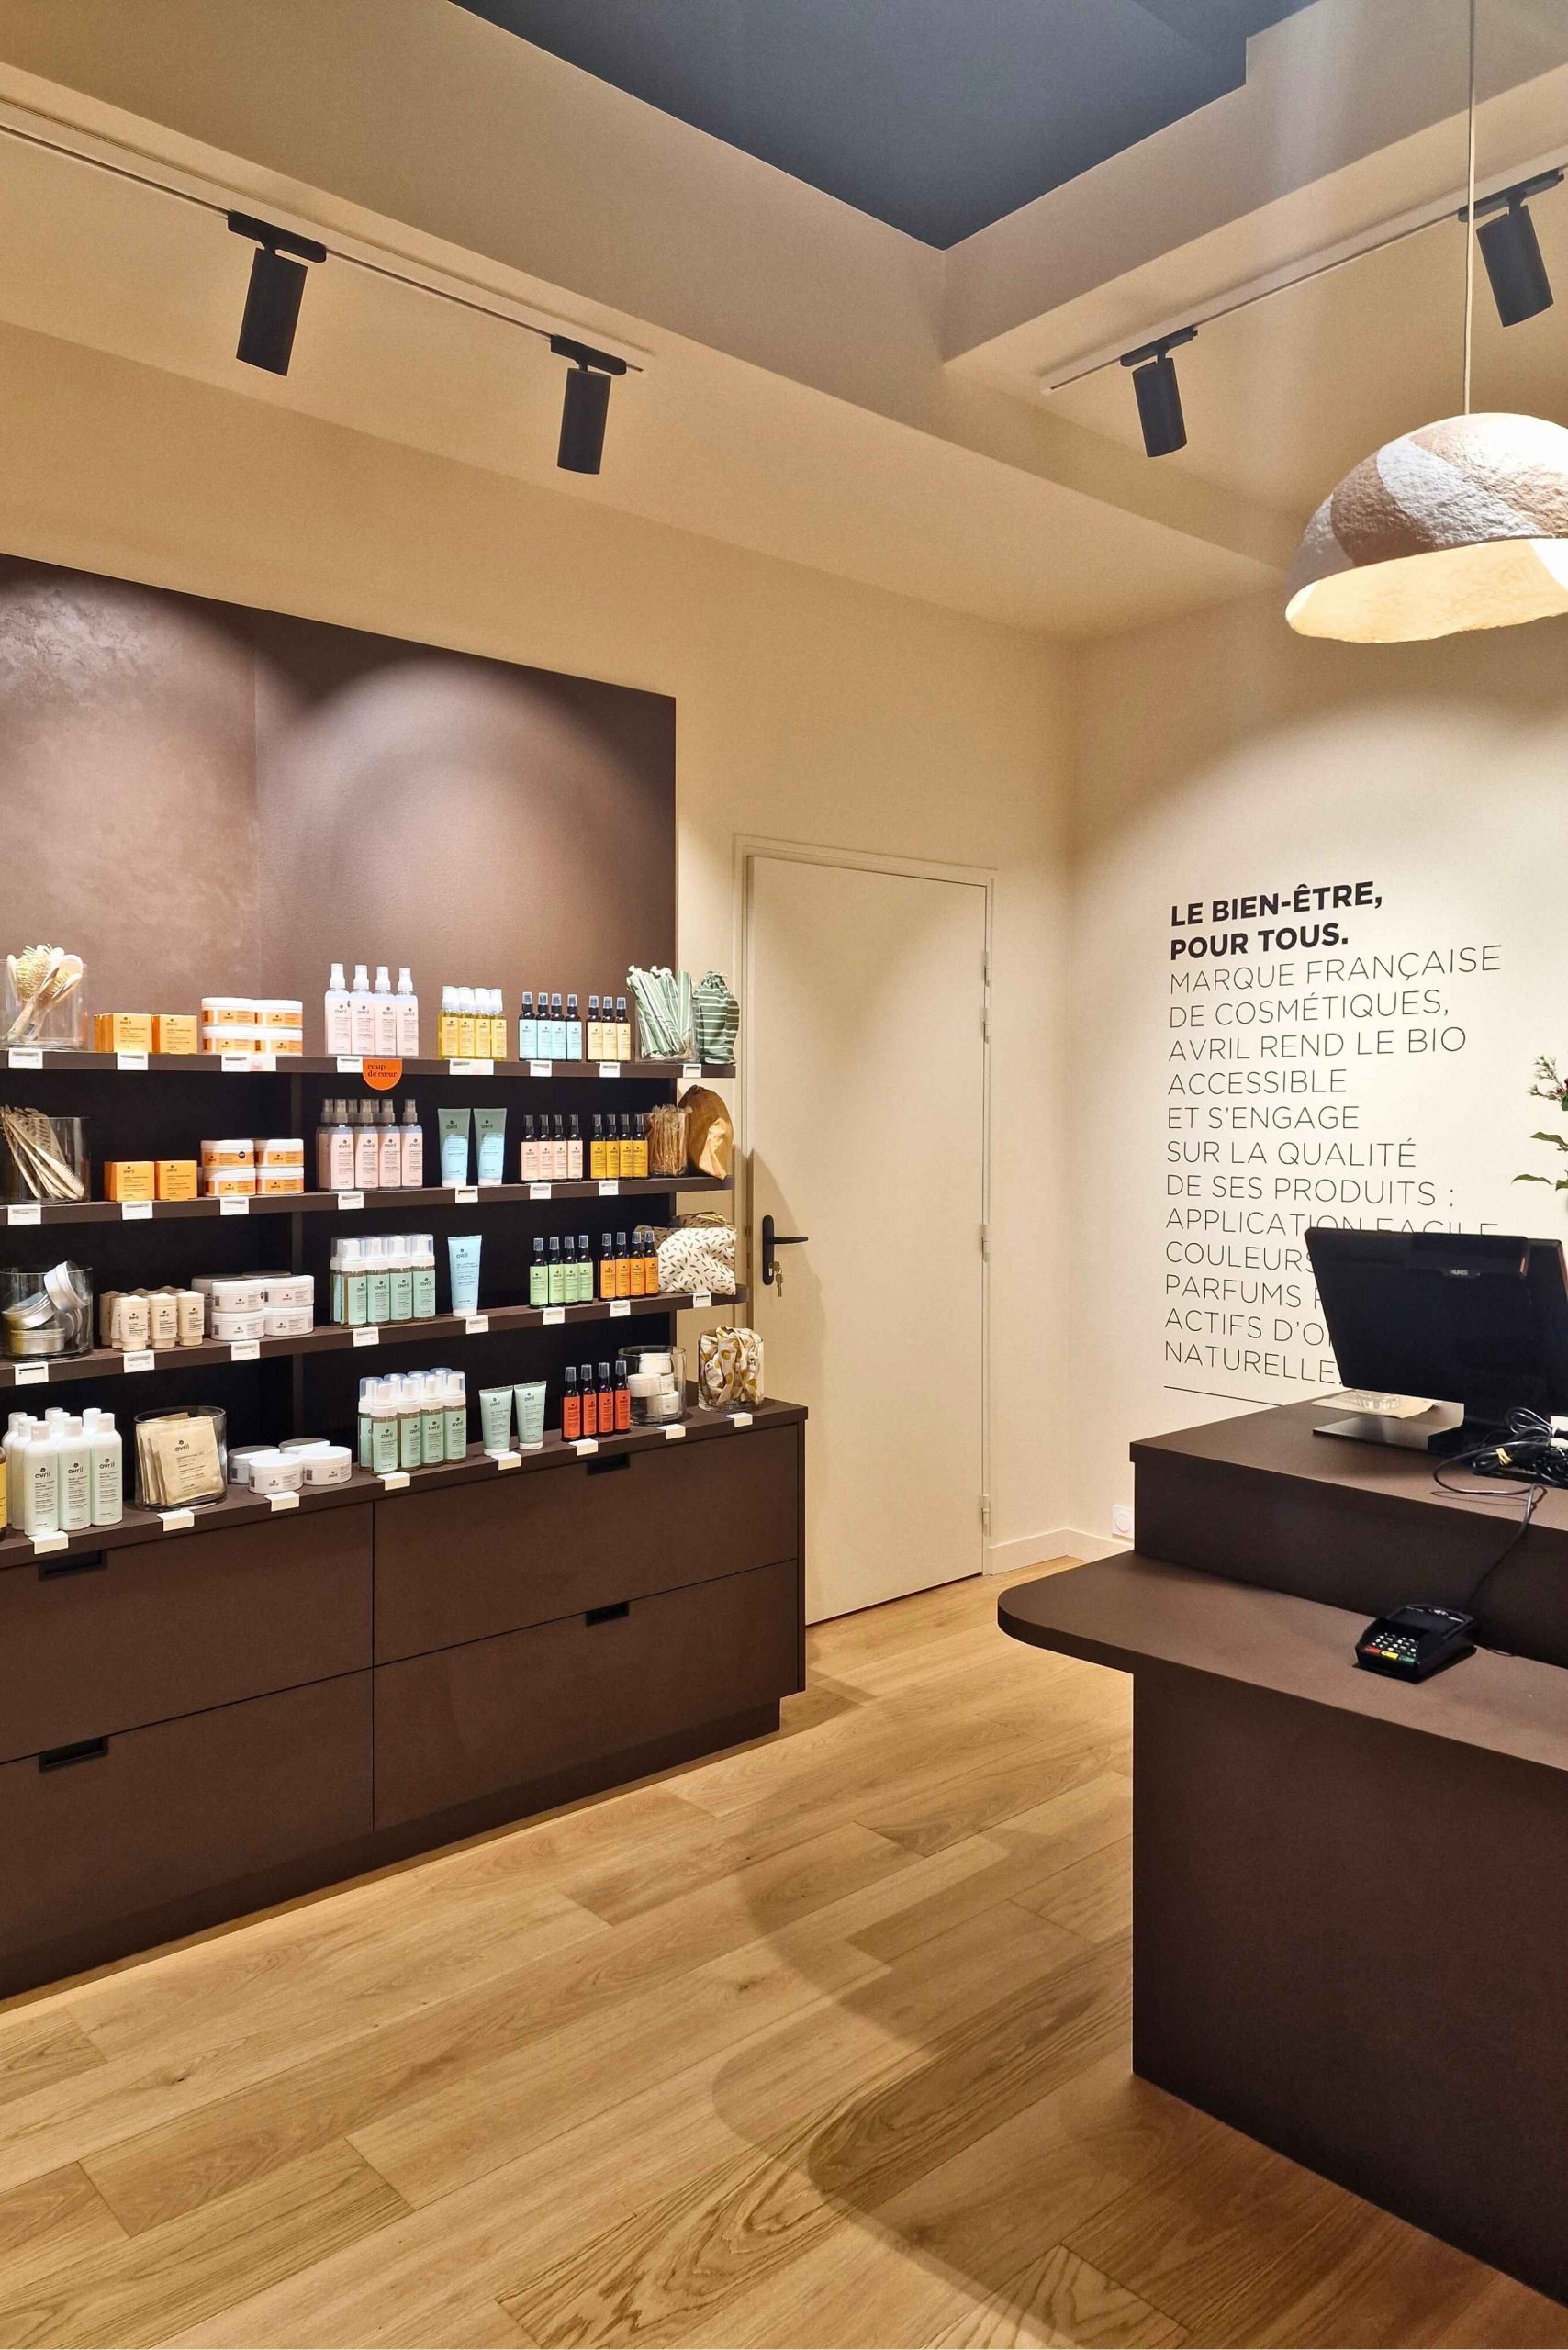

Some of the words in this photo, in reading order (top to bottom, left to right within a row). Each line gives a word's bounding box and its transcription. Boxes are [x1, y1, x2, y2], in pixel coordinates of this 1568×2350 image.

[1170, 901, 1204, 927] LE
[1212, 881, 1383, 923] BIEN-ÊTRE,
[1170, 932, 1249, 961] POUR
[1258, 922, 1350, 953] TOUS.
[1170, 962, 1295, 995] MARQUE
[1306, 944, 1502, 985] FRANÇAISE
[1170, 1004, 1204, 1029] DE
[1215, 989, 1449, 1025] COSMÉTIQUES,
[1168, 1036, 1250, 1062] AVRIL
[1260, 1033, 1344, 1058] REND
[1357, 1029, 1394, 1056] LE
[1407, 1026, 1466, 1053] BIO
[1167, 1069, 1348, 1095] ACCESSIBLE
[1168, 1106, 1200, 1130] ET
[1207, 1105, 1360, 1130] S'ENGAGE
[1166, 1140, 1220, 1164] SUR
[1231, 1141, 1268, 1165] LA
[1277, 1138, 1417, 1168] QUALITÉ
[1167, 1173, 1202, 1197] DE
[1211, 1175, 1263, 1200] SES
[1274, 1177, 1436, 1207] PRODUITS
[1165, 1273, 1302, 1308] PARFUMS
[1164, 1307, 1262, 1339] ACTIFS
[175, 1443, 190, 1451] avril
